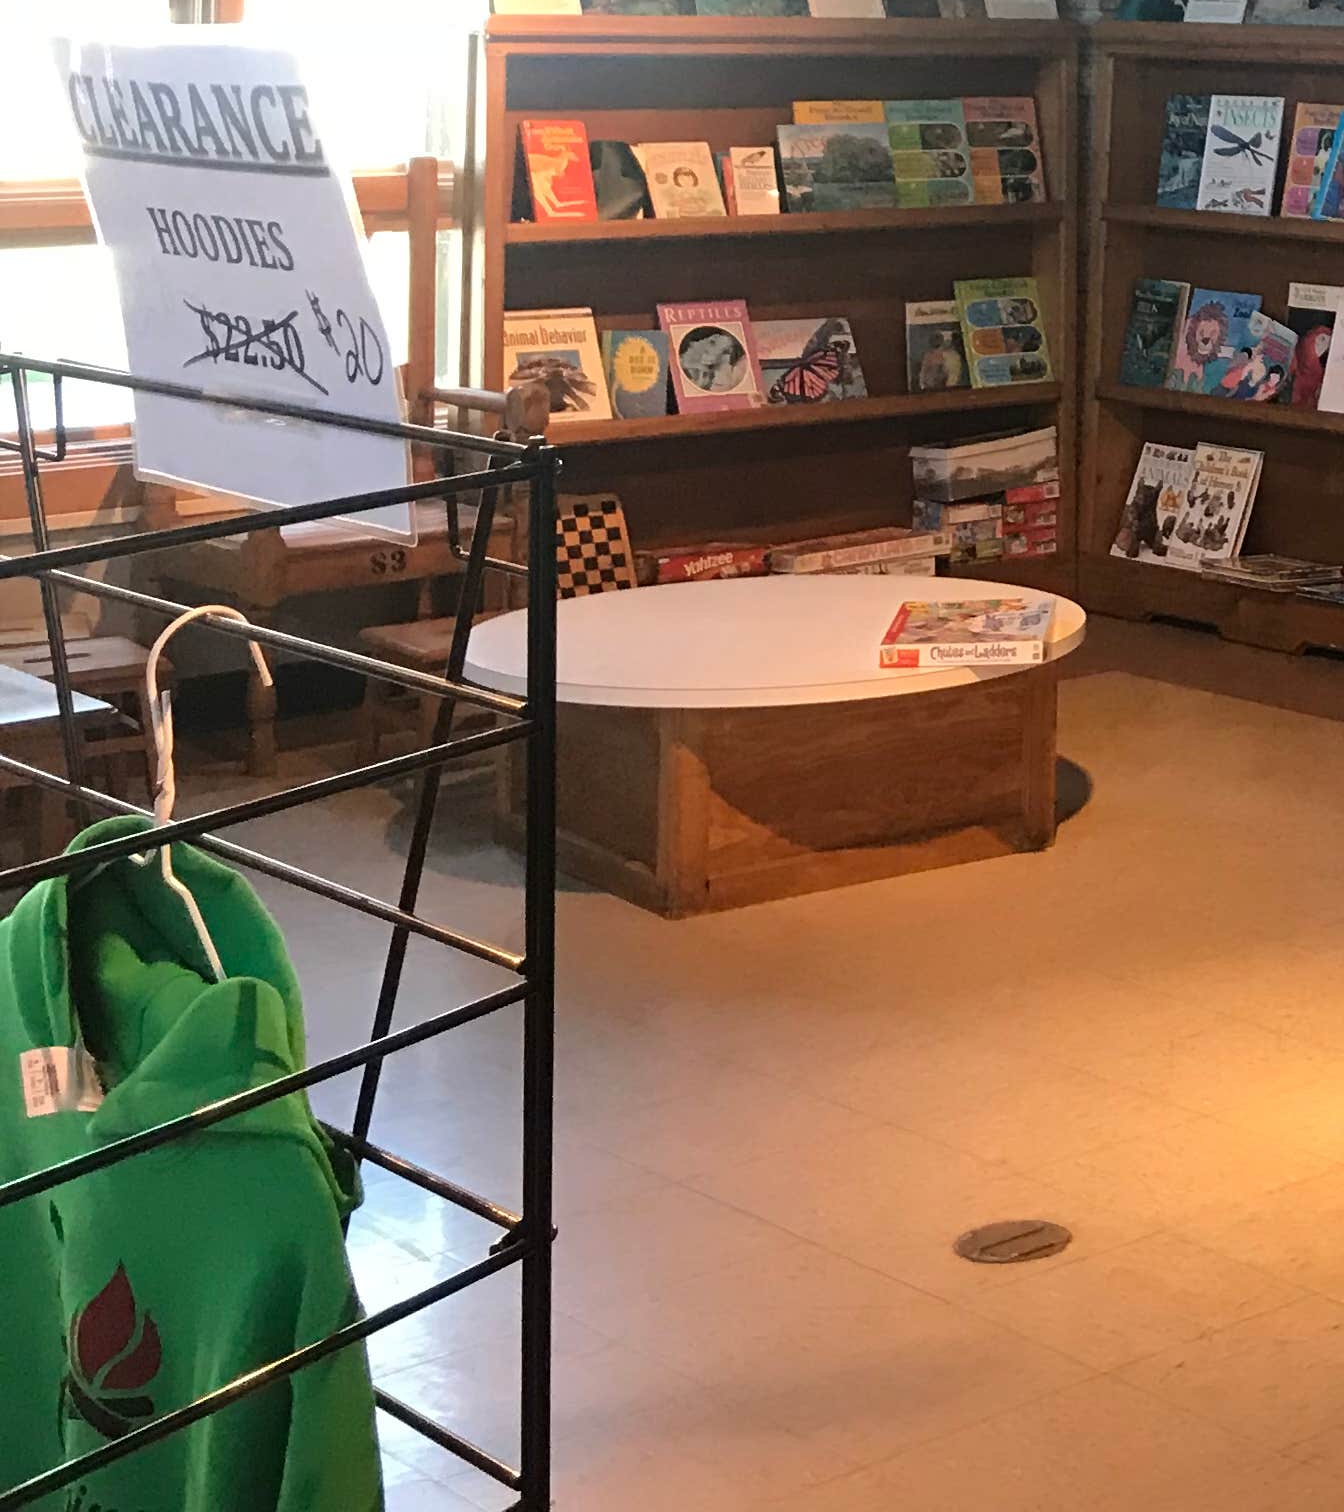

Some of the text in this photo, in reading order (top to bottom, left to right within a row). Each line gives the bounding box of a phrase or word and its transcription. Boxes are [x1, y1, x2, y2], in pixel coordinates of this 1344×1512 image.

[68, 72, 325, 163] CLEARANCE
[147, 207, 295, 271] HOODIES
[305, 288, 384, 386] $20
[539, 324, 587, 346] Behavior
[683, 551, 734, 577] Yahtzee
[930, 645, 964, 661] Chutes
[975, 643, 1018, 659] Ladders
